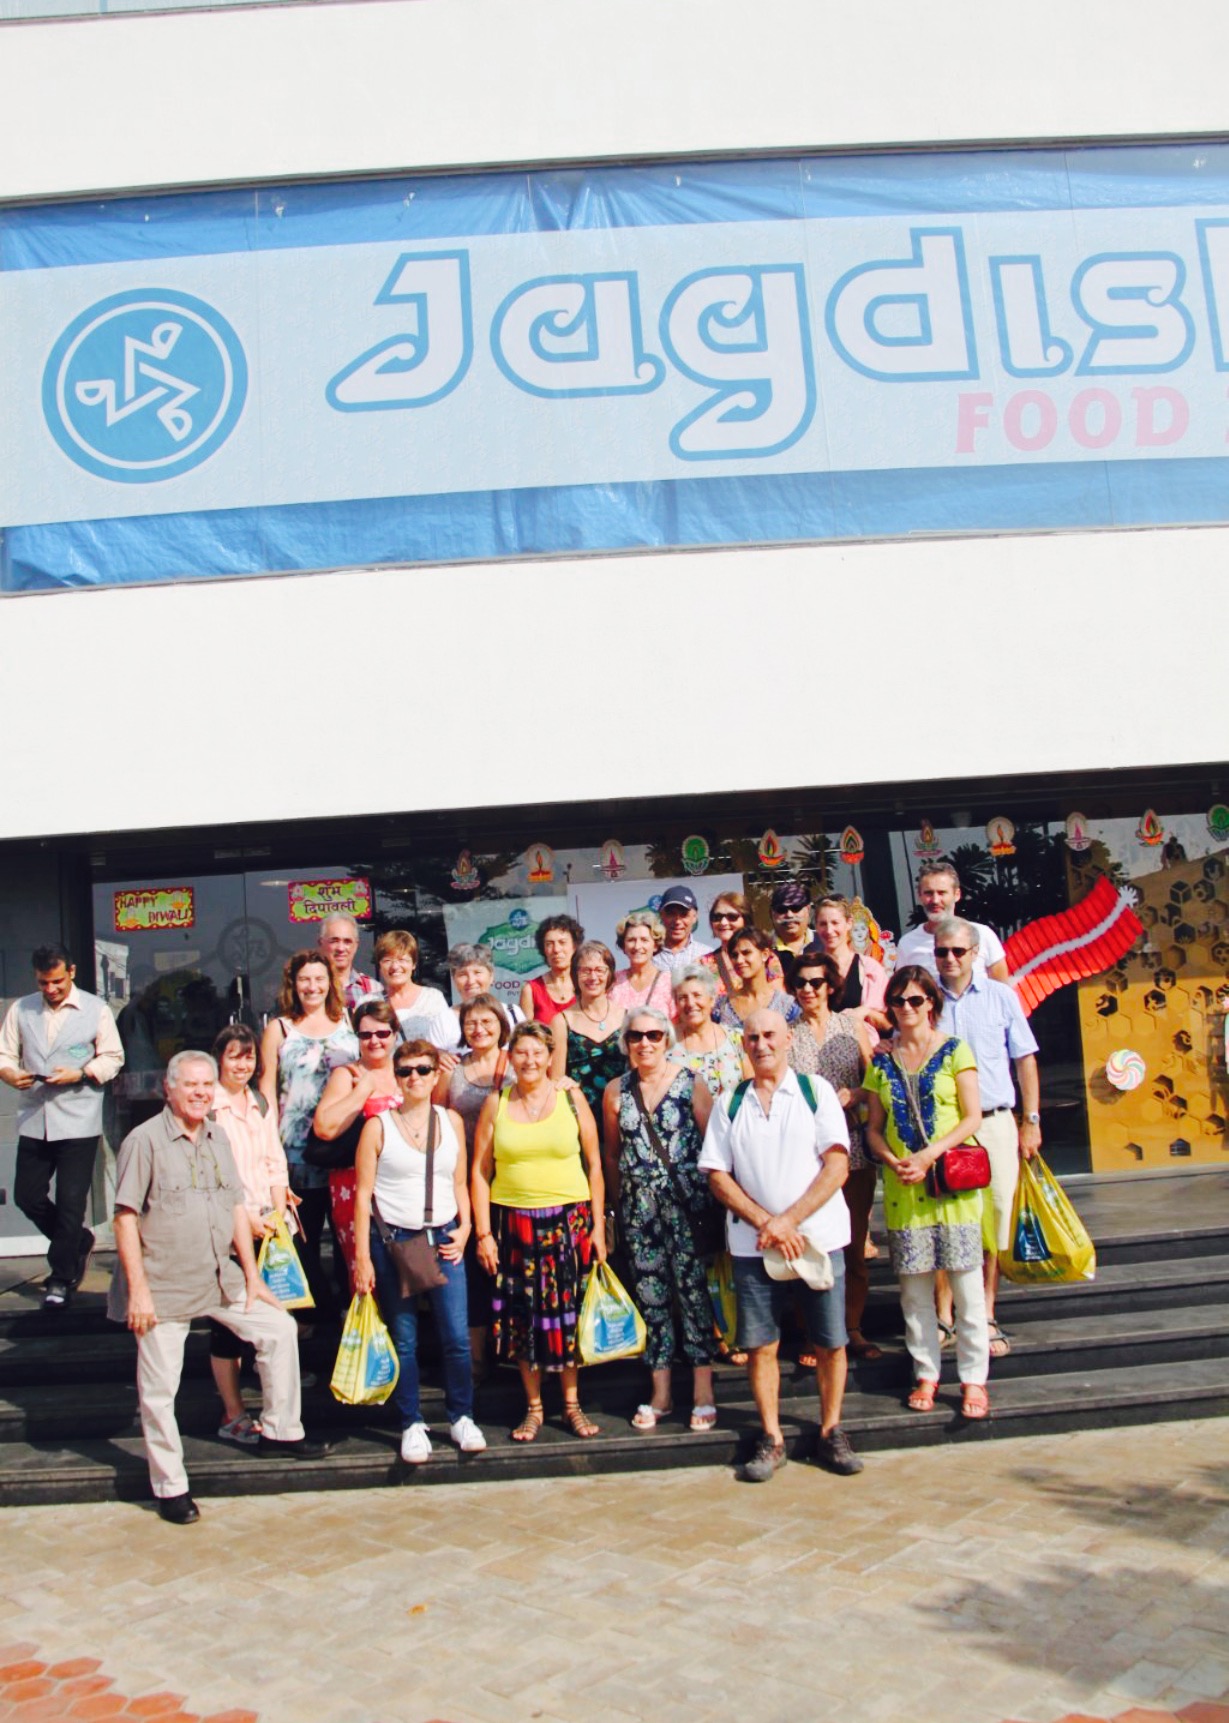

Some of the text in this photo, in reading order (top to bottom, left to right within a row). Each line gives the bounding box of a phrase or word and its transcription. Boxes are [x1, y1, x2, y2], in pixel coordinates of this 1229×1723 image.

[955, 385, 1190, 454] FOOD
[317, 886, 342, 901] शुभ
[120, 896, 158, 909] HAPPY
[148, 908, 189, 923] DIWALI
